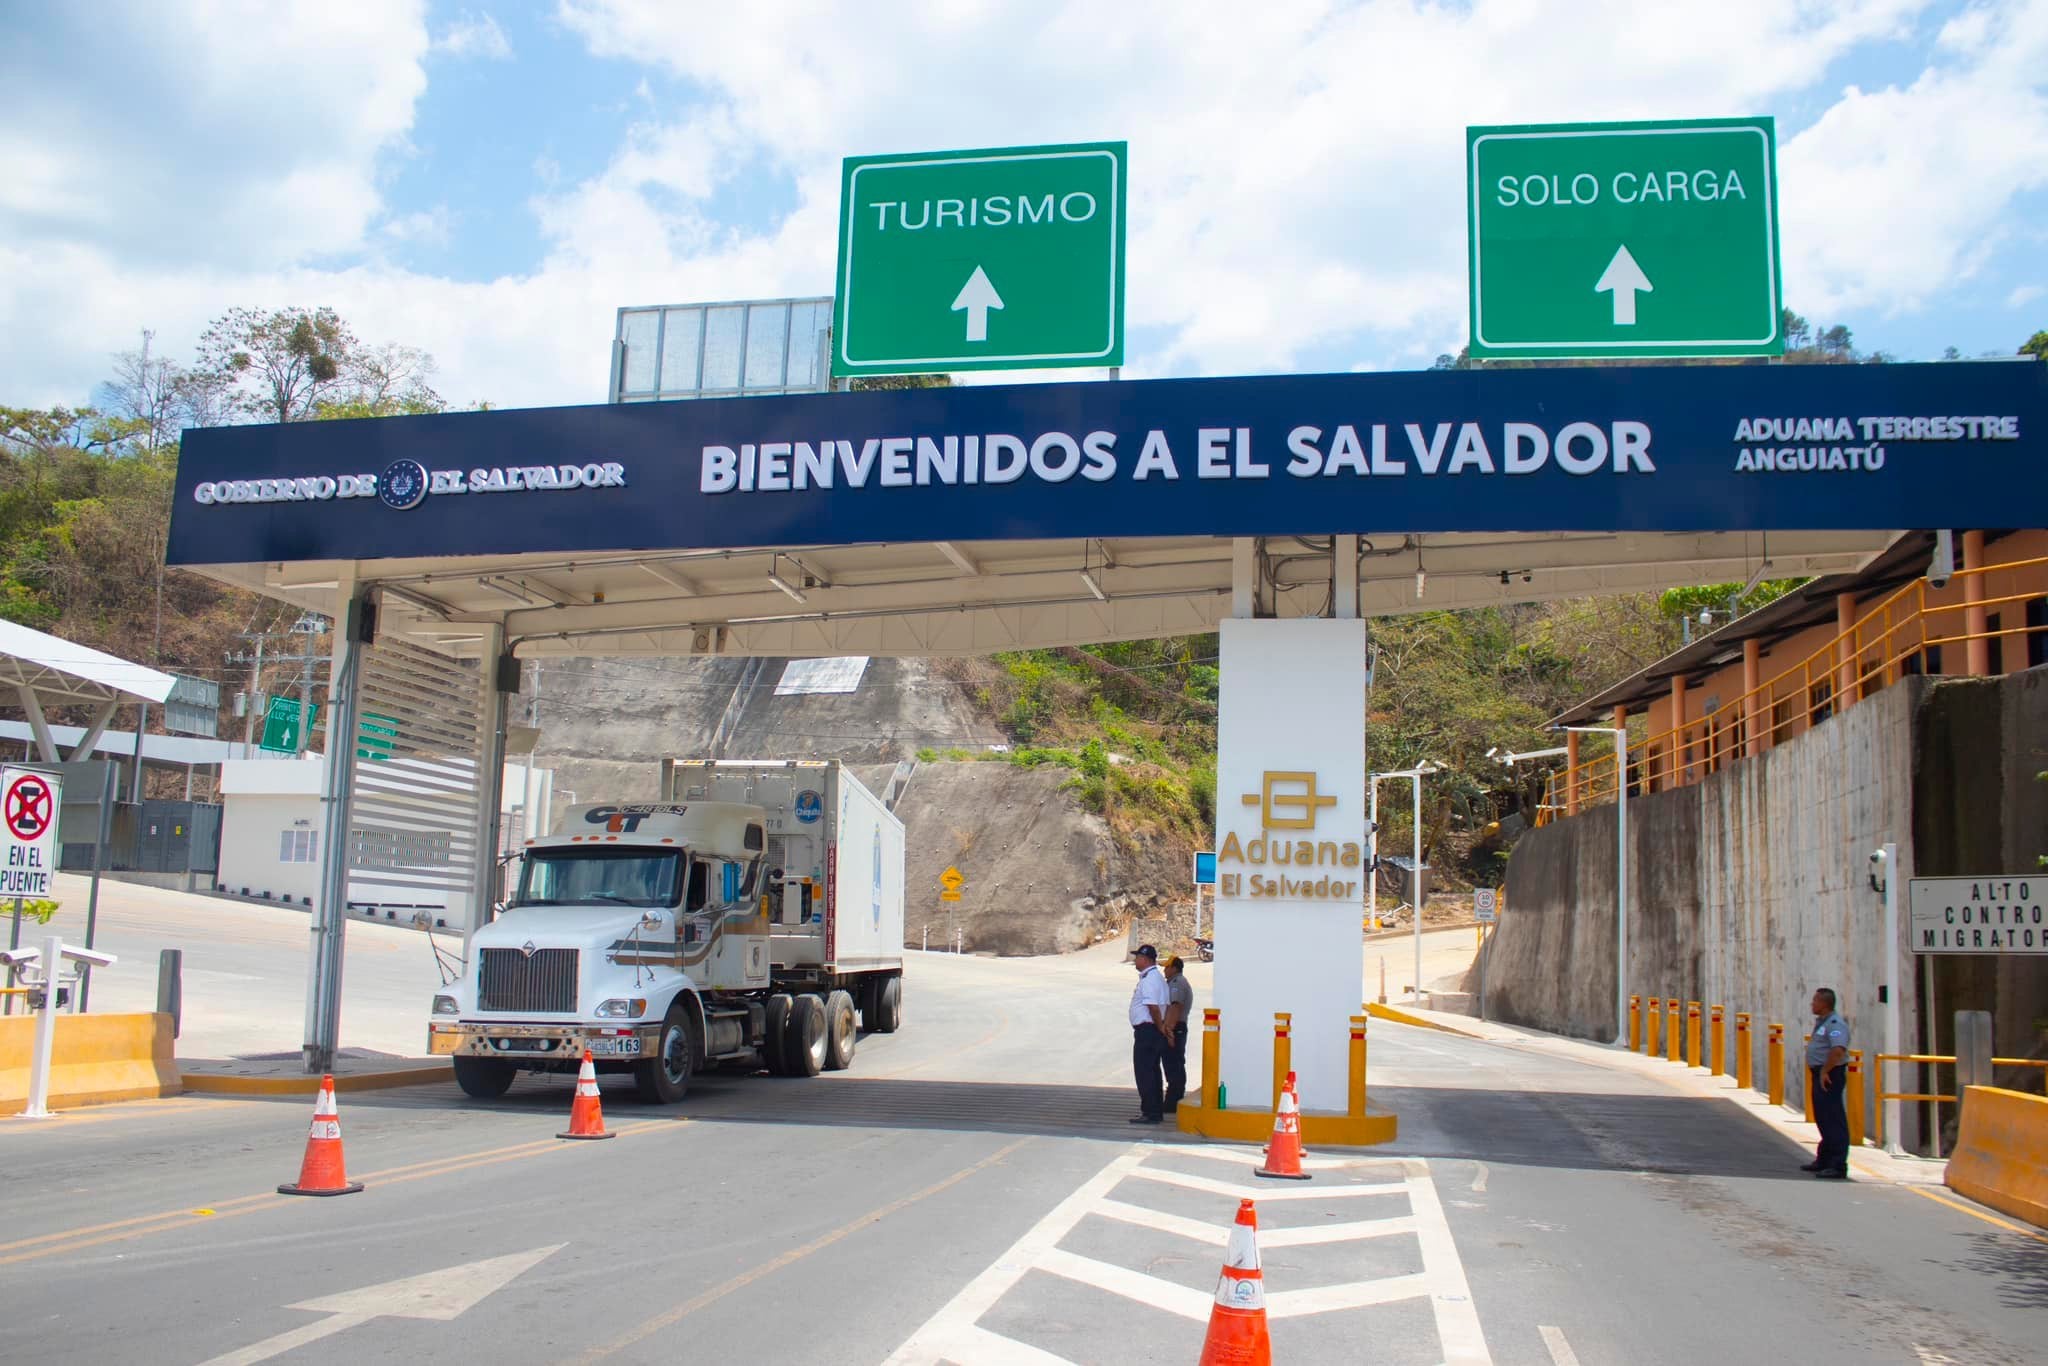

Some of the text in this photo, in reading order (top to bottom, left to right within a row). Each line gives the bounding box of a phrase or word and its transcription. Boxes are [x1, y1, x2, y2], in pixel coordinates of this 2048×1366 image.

[1497, 169, 1746, 207] SOLO CARGA
[869, 192, 1096, 231] TURISMO
[1733, 415, 2020, 442] ADUANA TERRESTRE
[700, 421, 1656, 494] BIENVENIDOS A EL SALVADOR
[1735, 442, 1885, 472] ANGUIATÚ
[194, 462, 626, 505] GOBIERNO DE EL SALVADOR
[9, 845, 42, 868] EN EL
[1218, 830, 1360, 867] Aduana
[0, 870, 47, 893] PUENTE
[1221, 873, 1357, 898] El Salvador
[1972, 881, 2029, 901] ALTO
[617, 1038, 640, 1052] 163
